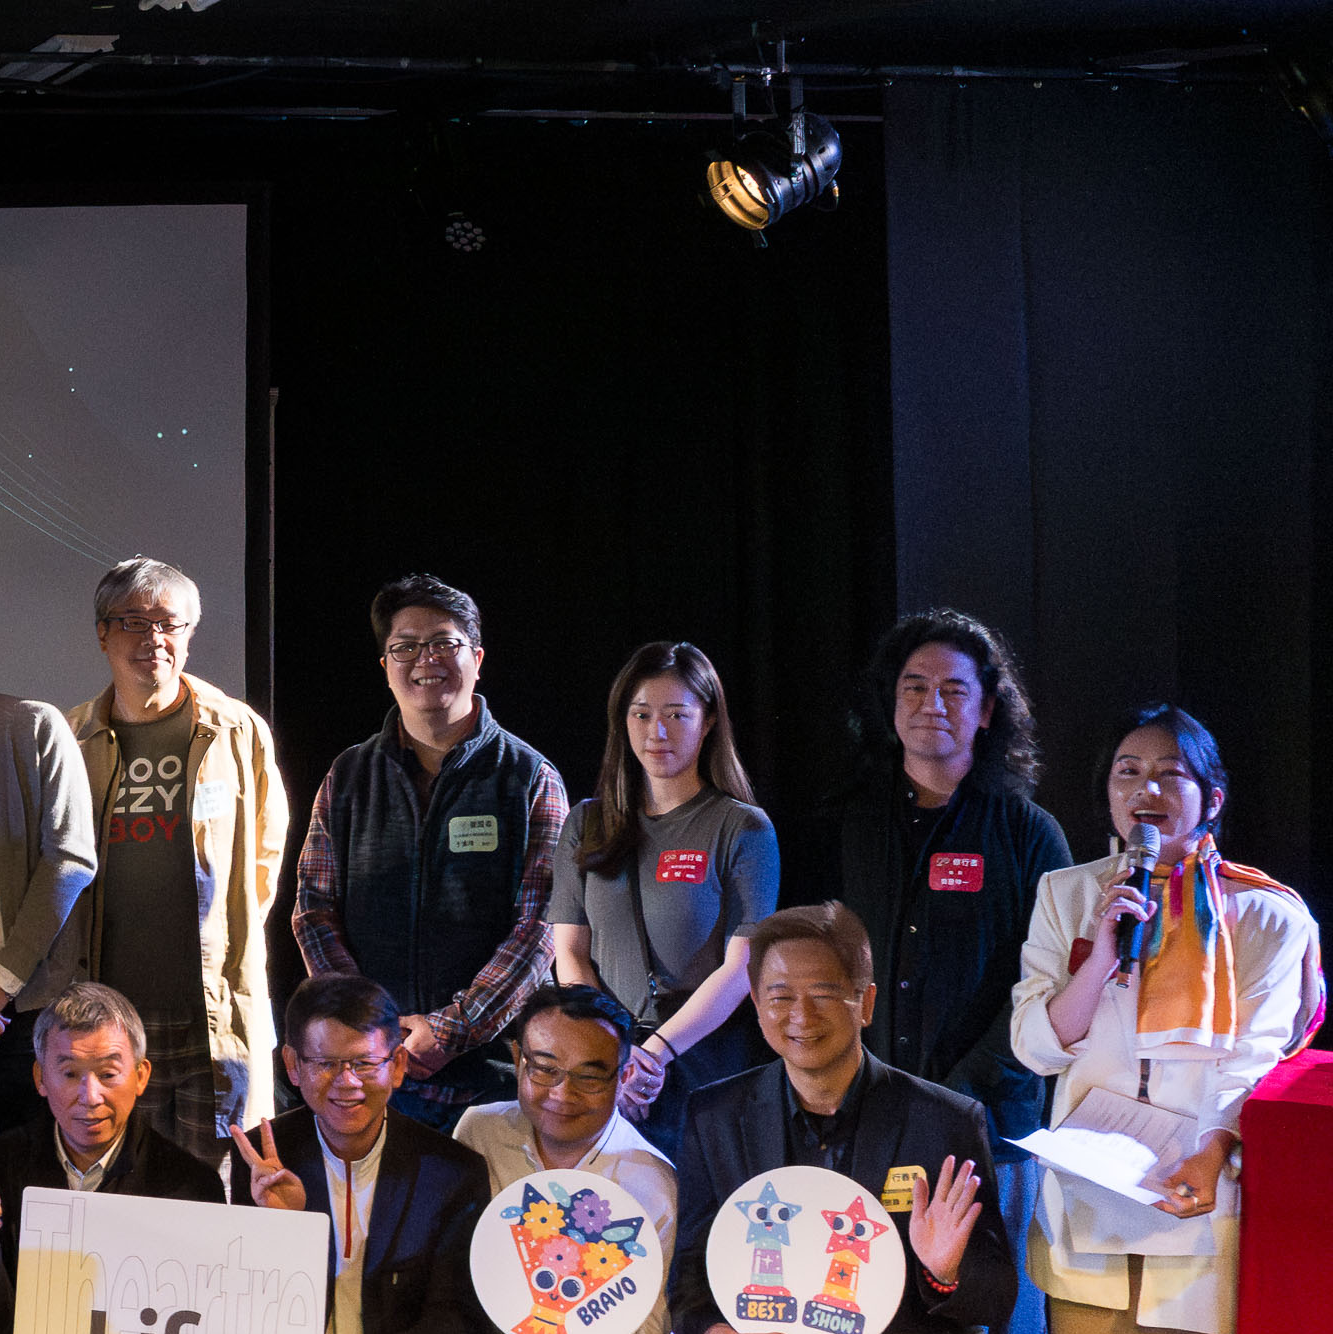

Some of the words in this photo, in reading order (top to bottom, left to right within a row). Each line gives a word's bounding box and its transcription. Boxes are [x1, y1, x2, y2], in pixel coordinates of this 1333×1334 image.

[576, 1276, 637, 1326] BRAVO
[747, 1301, 787, 1320] BEST
[811, 1309, 856, 1334] SHOW
